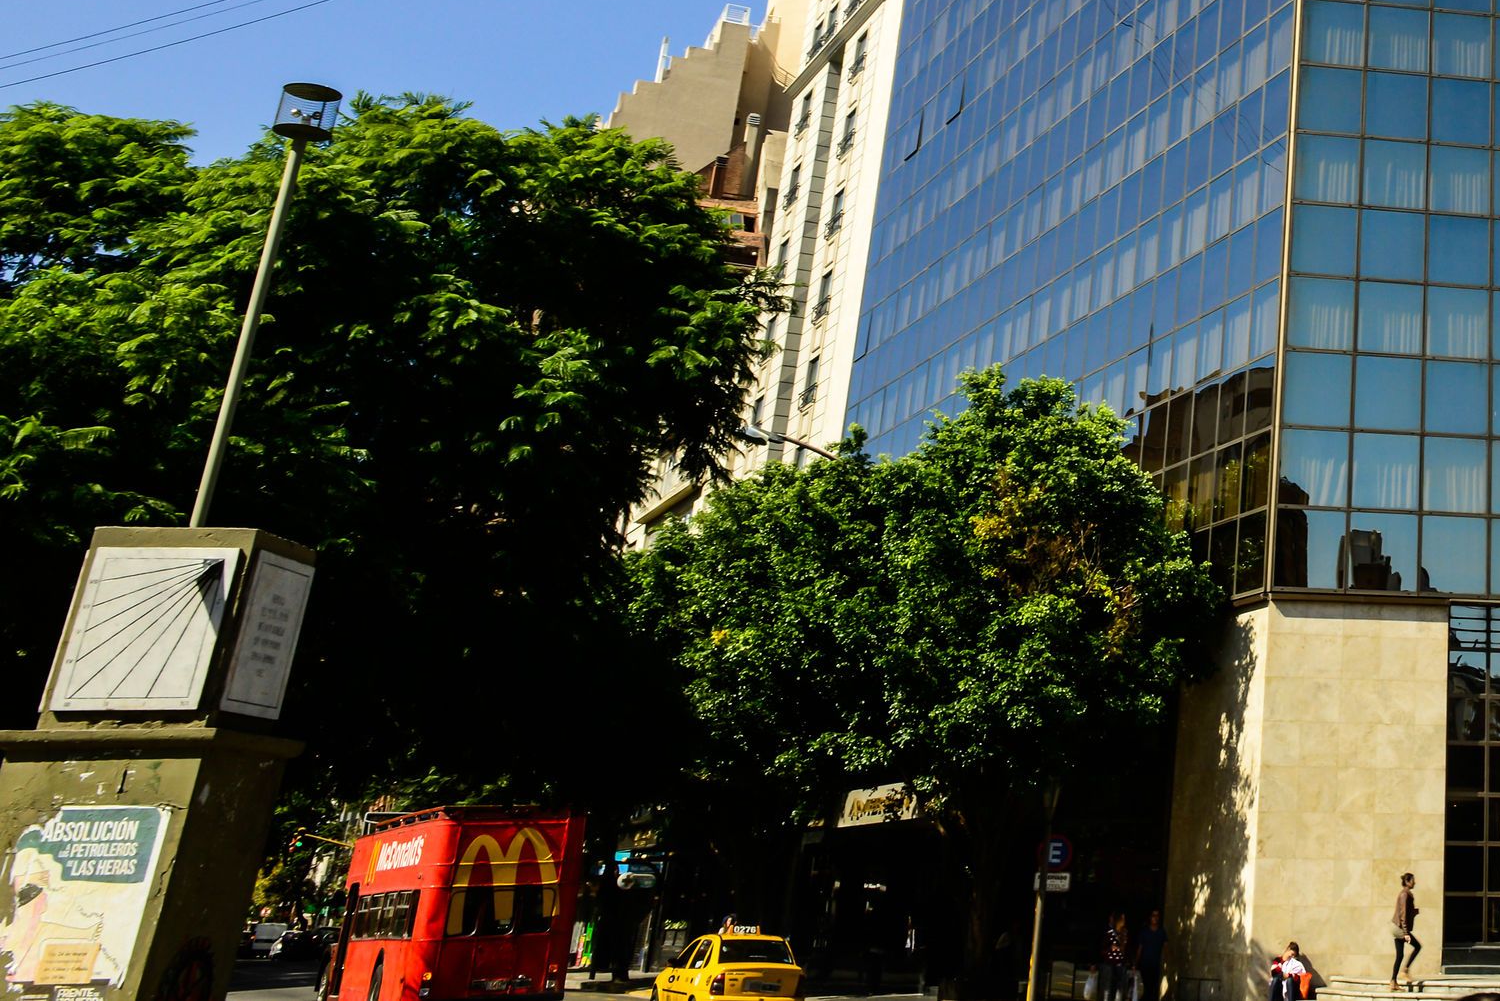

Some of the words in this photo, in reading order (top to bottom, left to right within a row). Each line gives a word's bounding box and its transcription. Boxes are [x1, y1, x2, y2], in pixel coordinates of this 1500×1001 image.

[40, 816, 140, 842] ABSOLUCIÓN
[69, 842, 138, 858] PETROLEROS
[376, 835, 425, 871] McDonald's
[1049, 842, 1063, 863] E
[70, 859, 96, 876] LAS
[95, 858, 138, 875] HERAS
[733, 925, 757, 934] 0276
[57, 987, 96, 998] FRENTE
